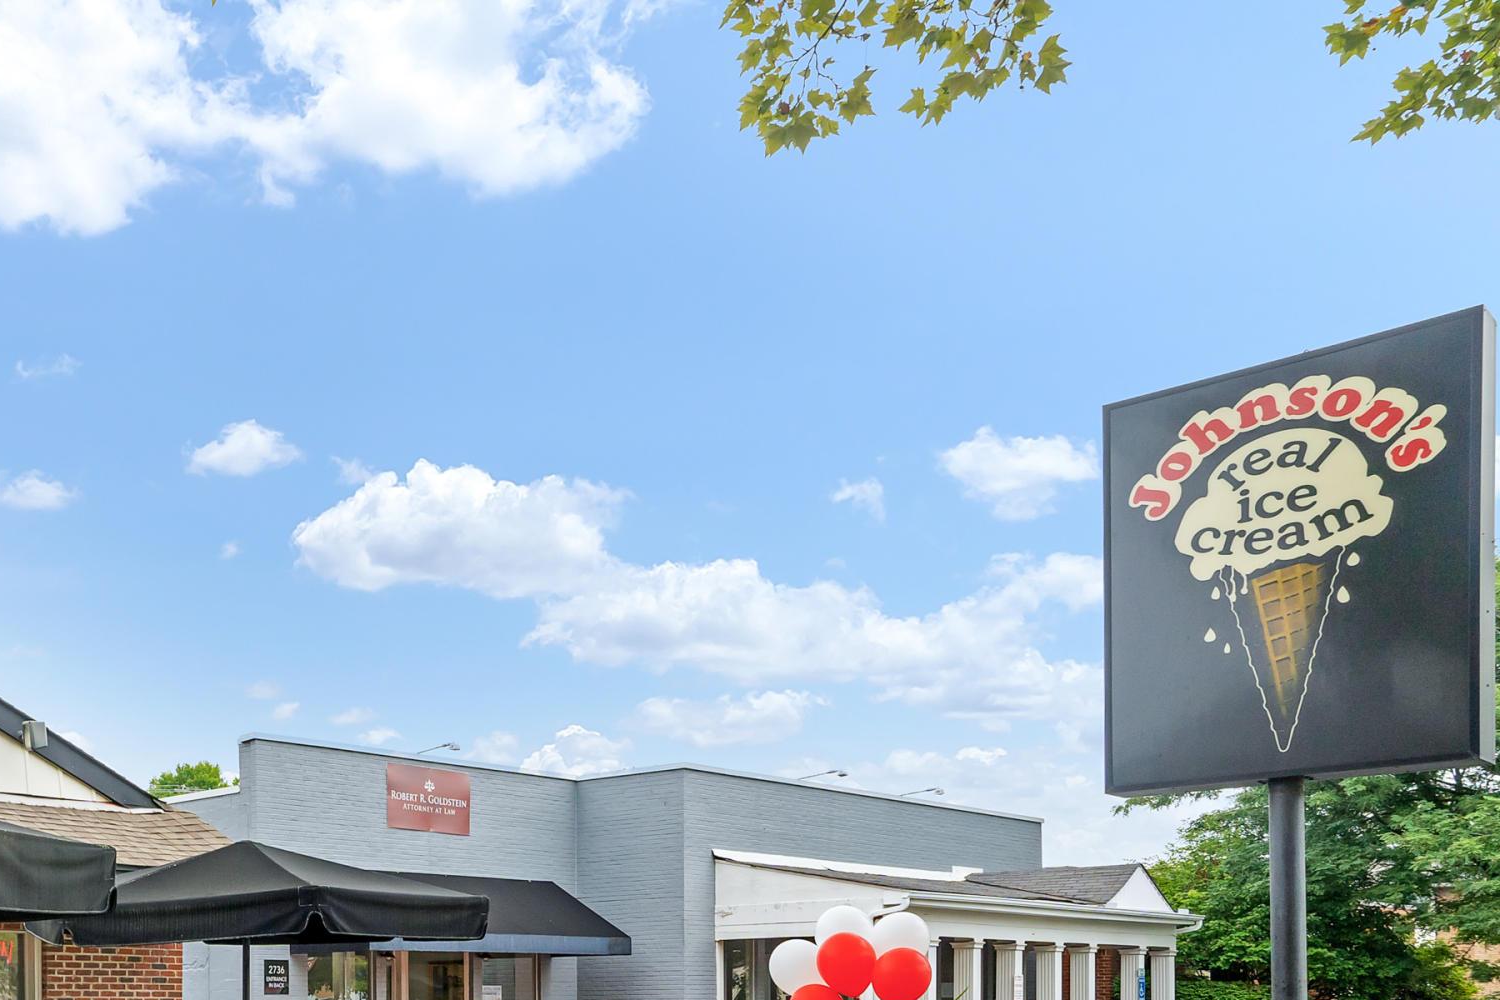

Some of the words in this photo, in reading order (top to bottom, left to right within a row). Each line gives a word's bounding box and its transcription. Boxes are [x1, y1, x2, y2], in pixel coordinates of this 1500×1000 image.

[1133, 386, 1432, 518] Johnson's
[1217, 437, 1342, 491] real
[1237, 484, 1317, 523] ice
[1190, 498, 1374, 556] cream
[391, 790, 418, 802] ROBERT
[428, 795, 467, 808] GOLDSTEIN
[403, 803, 433, 813] ATTORNEY
[444, 807, 456, 815] LAW
[268, 965, 285, 975] 2736
